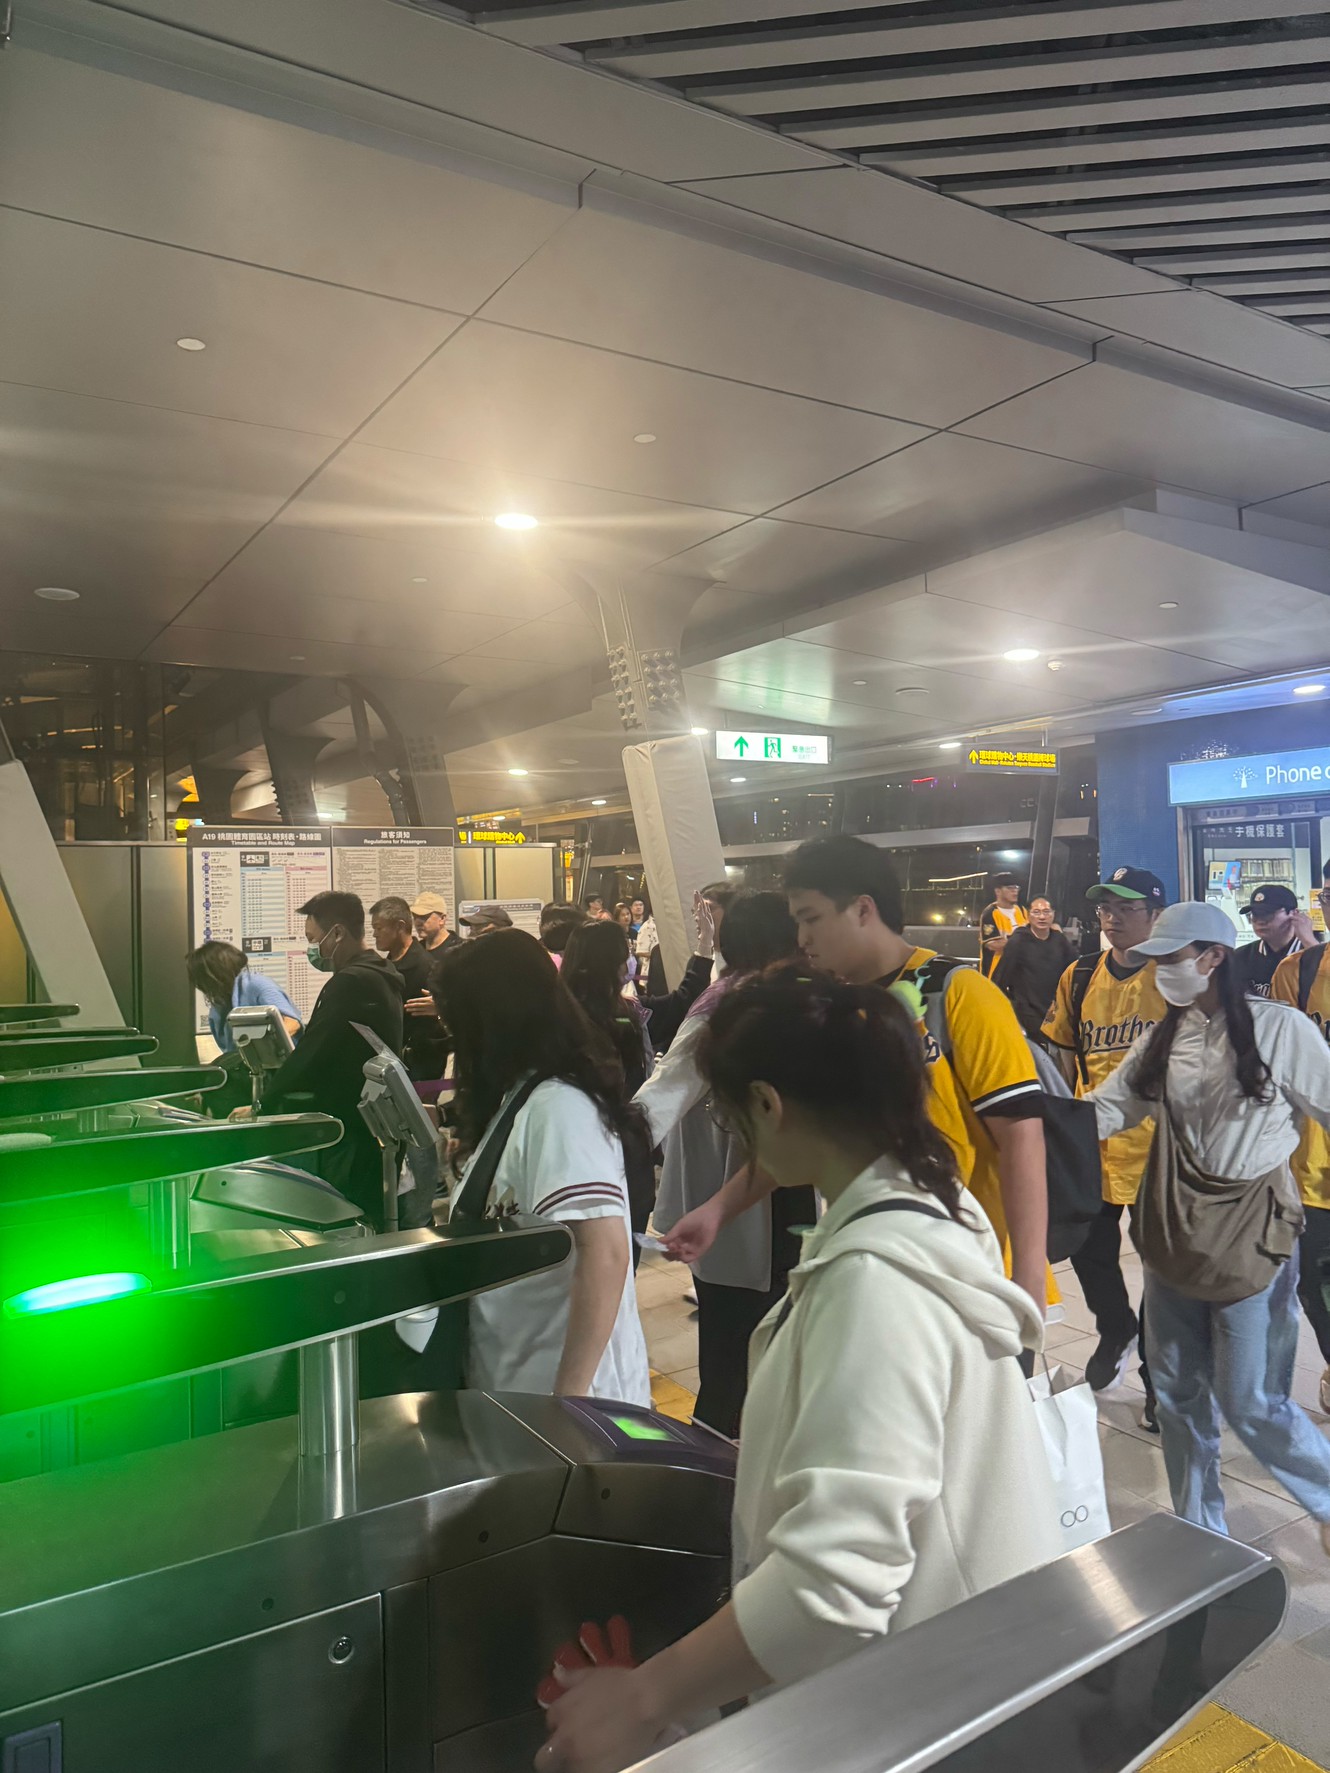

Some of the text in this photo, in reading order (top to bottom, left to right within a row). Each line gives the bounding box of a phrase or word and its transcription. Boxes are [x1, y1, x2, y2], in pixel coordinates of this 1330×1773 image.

[1265, 764, 1322, 785] Phone
[380, 831, 411, 839] 旅客須知
